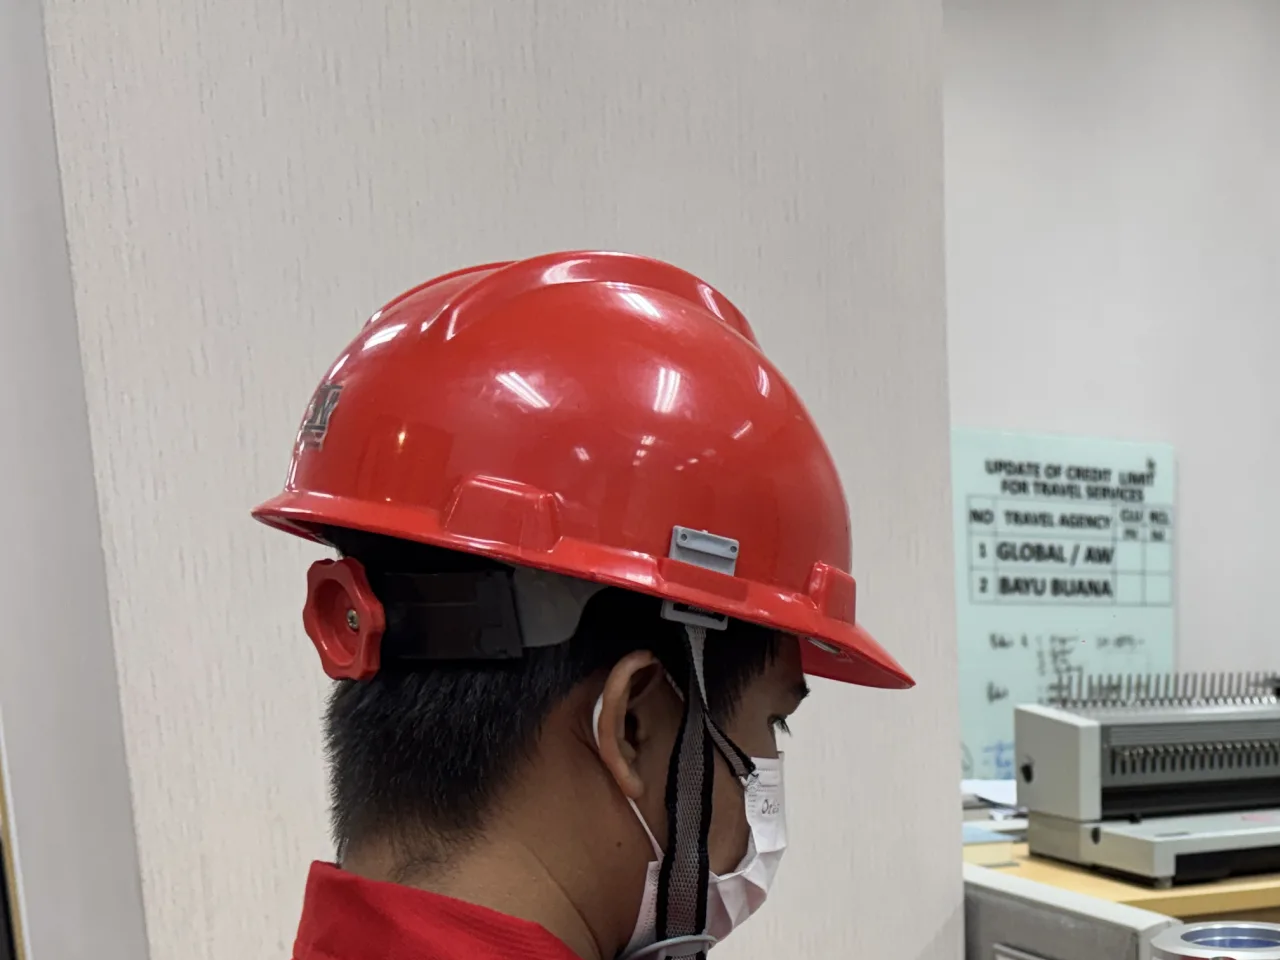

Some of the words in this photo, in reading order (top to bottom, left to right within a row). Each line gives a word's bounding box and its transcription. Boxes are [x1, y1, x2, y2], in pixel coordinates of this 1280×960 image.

[985, 458, 1040, 479] UPDATE
[1044, 463, 1062, 480] OF
[1066, 465, 1112, 483] CREDIT
[1001, 479, 1029, 495] FOR
[1033, 481, 1082, 499] TRAVEL
[1086, 485, 1144, 502] SERVICES
[1004, 510, 1054, 528] TRAVEL
[1059, 513, 1112, 529] AGENCY
[996, 541, 1067, 564] GLOBAL
[1084, 546, 1115, 564] AW
[979, 576, 988, 594] 2
[997, 576, 1047, 596] BAYU
[1051, 578, 1113, 597] BUANA
